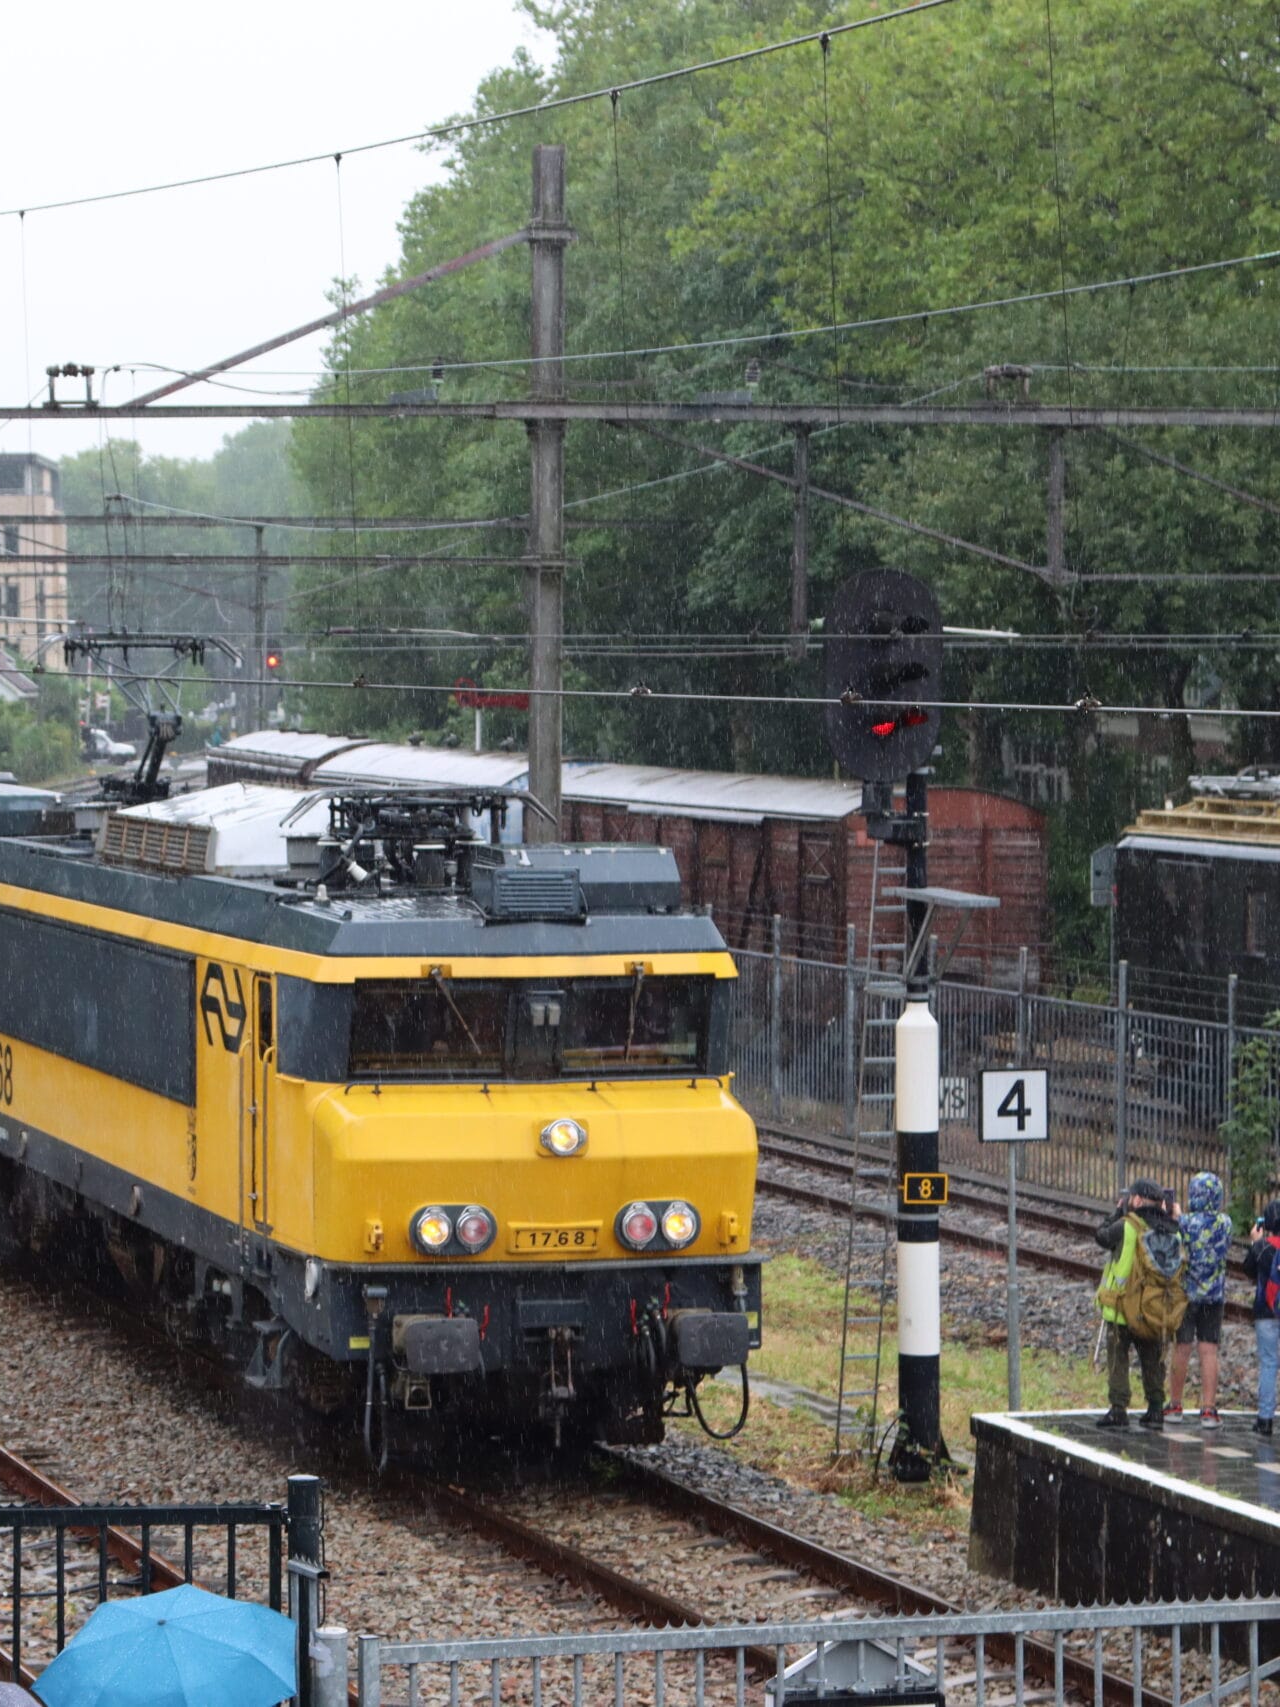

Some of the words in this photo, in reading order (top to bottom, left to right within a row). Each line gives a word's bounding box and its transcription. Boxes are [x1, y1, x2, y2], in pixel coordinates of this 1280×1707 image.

[997, 1079, 1031, 1131] 4
[921, 1178, 932, 1199] 8
[529, 1231, 585, 1246] 1768
